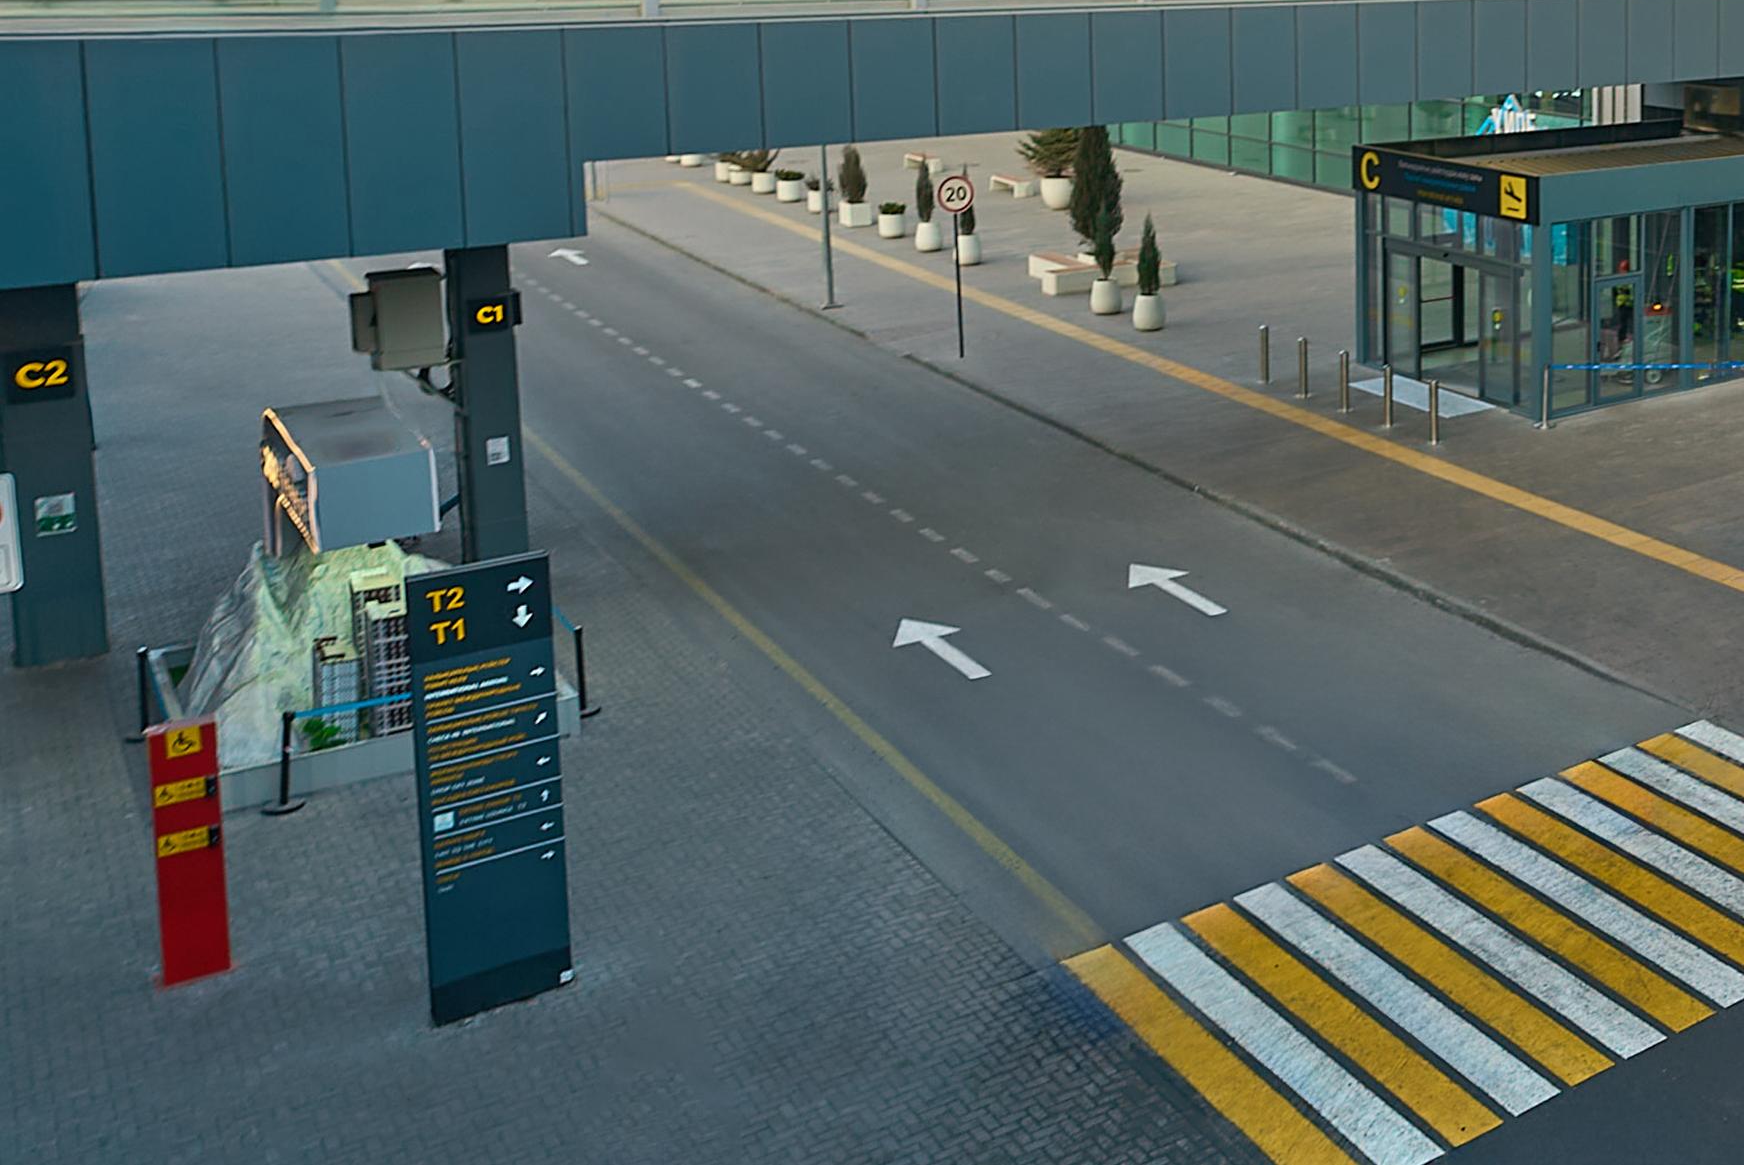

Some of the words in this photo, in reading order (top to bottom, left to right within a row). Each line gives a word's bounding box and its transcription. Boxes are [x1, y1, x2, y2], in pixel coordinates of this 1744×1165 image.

[1360, 151, 1381, 190] C
[946, 186, 967, 202] 20
[475, 304, 505, 325] C1
[14, 358, 69, 390] C2
[425, 586, 465, 613] T2
[429, 617, 465, 645] T1
